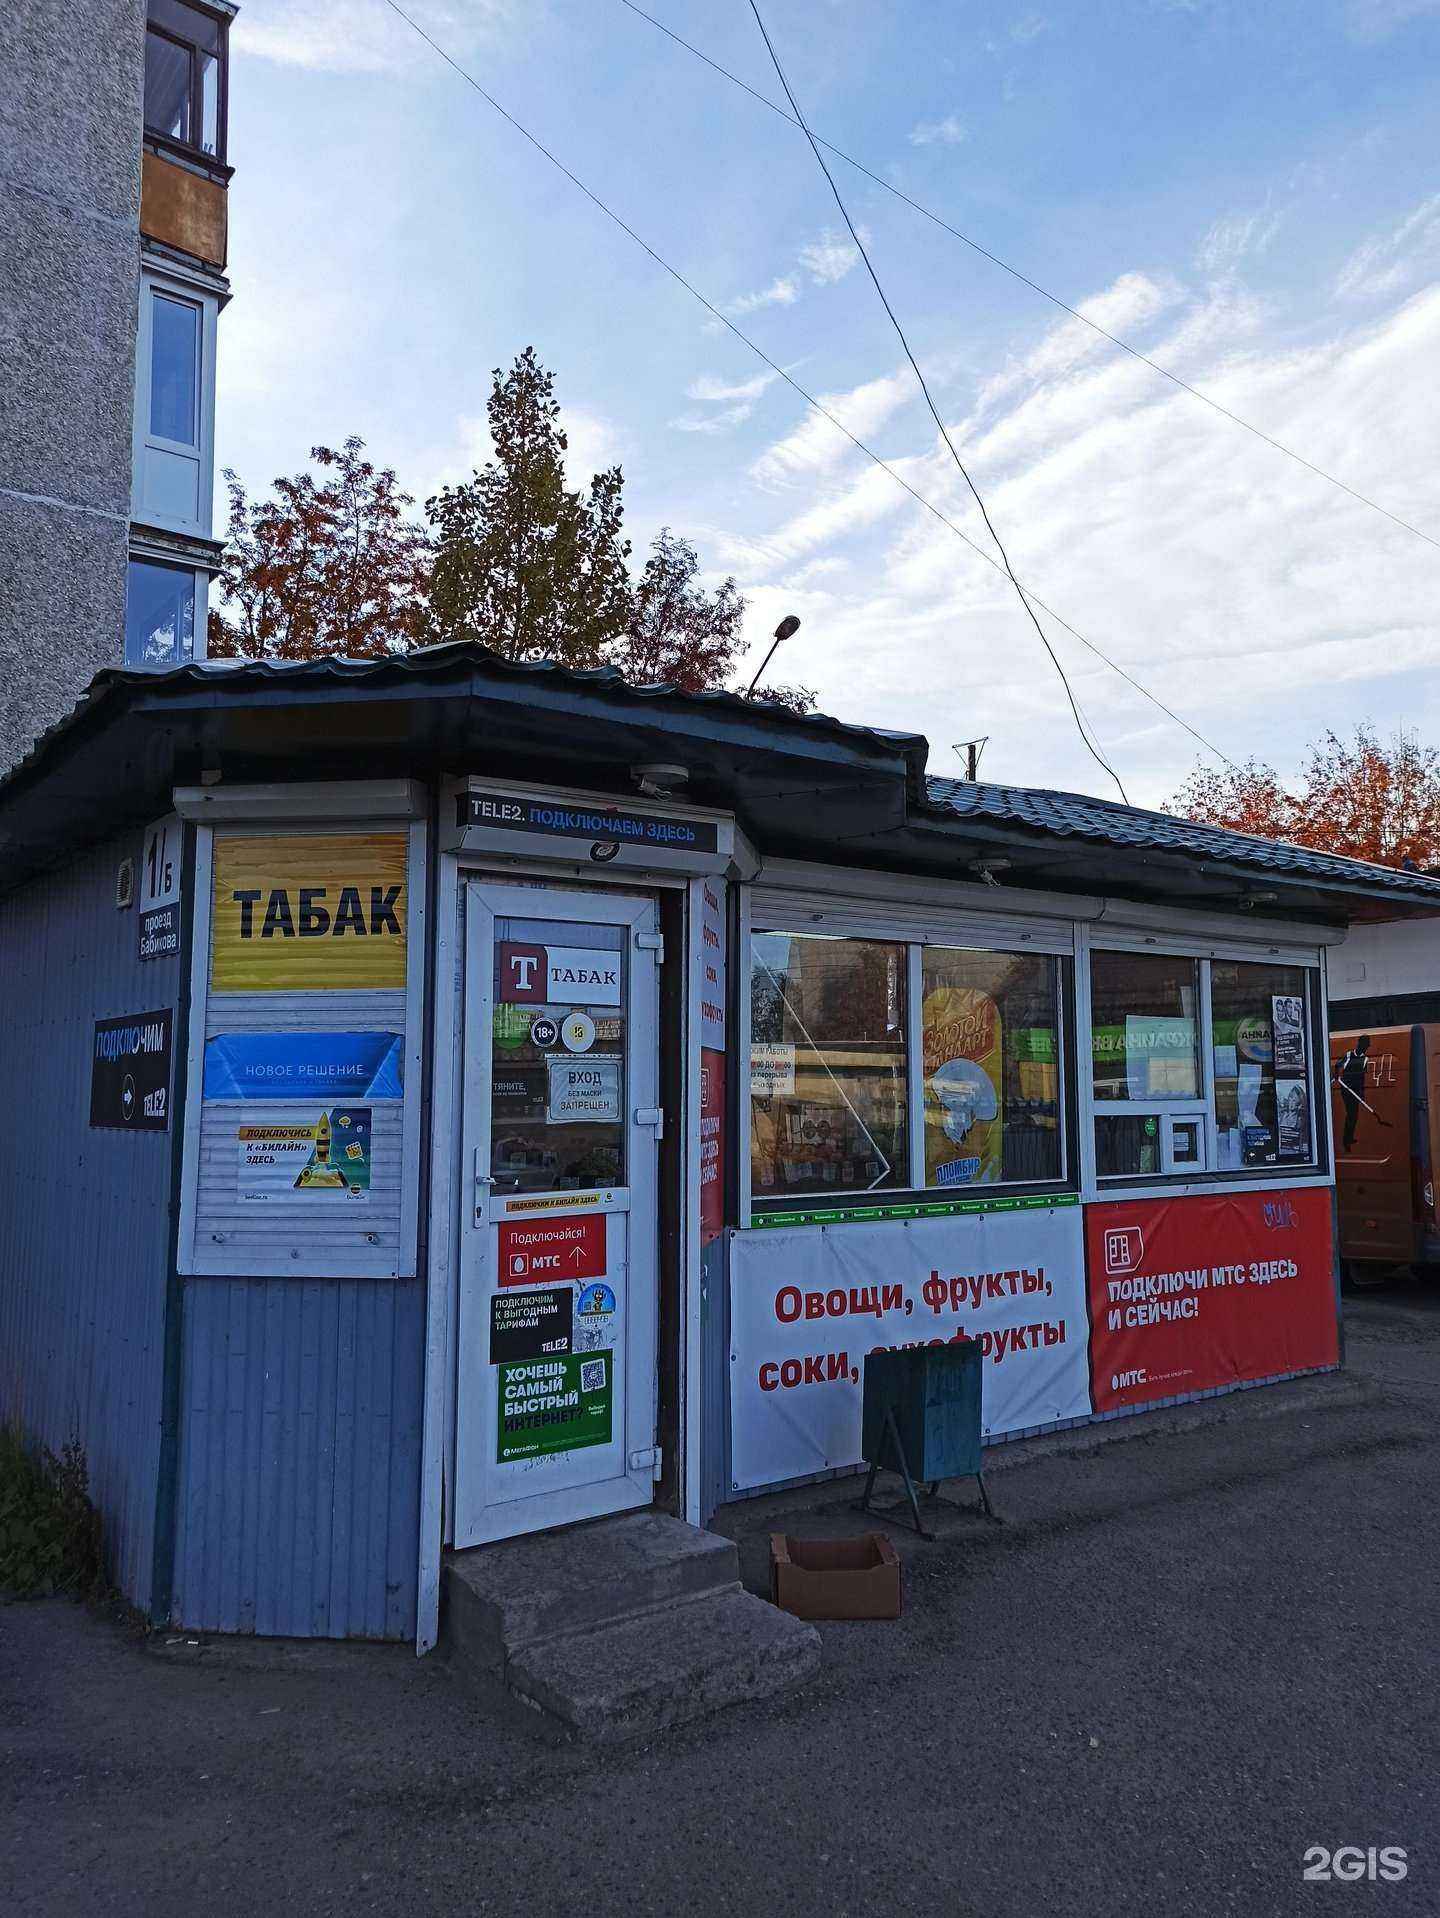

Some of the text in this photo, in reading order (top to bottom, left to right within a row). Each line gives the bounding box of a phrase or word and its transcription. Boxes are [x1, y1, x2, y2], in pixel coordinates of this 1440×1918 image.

[530, 808, 643, 836] ПОДКЛЮЧАЕМ
[647, 822, 696, 842] ЗДЕСЬ
[233, 886, 402, 939] ТАБАК
[144, 911, 171, 935] проезд
[140, 932, 177, 955] Бабикова
[551, 968, 617, 985] ТАБАК
[536, 1026, 553, 1039] 18+
[96, 1023, 164, 1062] ПОДКЛЮЧИМ
[246, 1063, 365, 1077] НОВОЕ РЕШЕНИЕ
[568, 1071, 602, 1087] ВХОД
[144, 1087, 166, 1117] TELE2
[581, 1089, 602, 1097] МАСКИ
[561, 1100, 609, 1111] ЗАПРЕЩЕН
[246, 1128, 312, 1139] ПОДКЛЮЧИСЬ
[247, 1141, 307, 1152] К «БИЛАЙН»
[246, 1155, 275, 1165] ЗДЕСЬ
[937, 1158, 980, 1184] ПЛОМБИР
[510, 1226, 587, 1244] Подключайся!
[532, 1255, 560, 1269] МТС
[1107, 1259, 1298, 1302] ПОДКЛЮЧИ МТС ЗДЕСЬ
[495, 1295, 554, 1308] ПОДКЛЮЧИМ
[775, 1268, 1053, 1323] Овощи, фрукты,
[495, 1304, 558, 1320] К ВЫГОДНЫМ
[1108, 1297, 1199, 1331] И СЕЙЧАС!
[495, 1318, 539, 1331] ТАРИФАМ
[542, 1337, 568, 1352] TELE2
[505, 1362, 567, 1382] ХОЧЕШЬ
[758, 1352, 860, 1392] соки,
[1119, 1369, 1147, 1388] МТС
[505, 1376, 563, 1399] САМЫЙ
[504, 1389, 579, 1416] БЫСТРЫЙ
[505, 1408, 583, 1432] ИНТЕРНЕТ?
